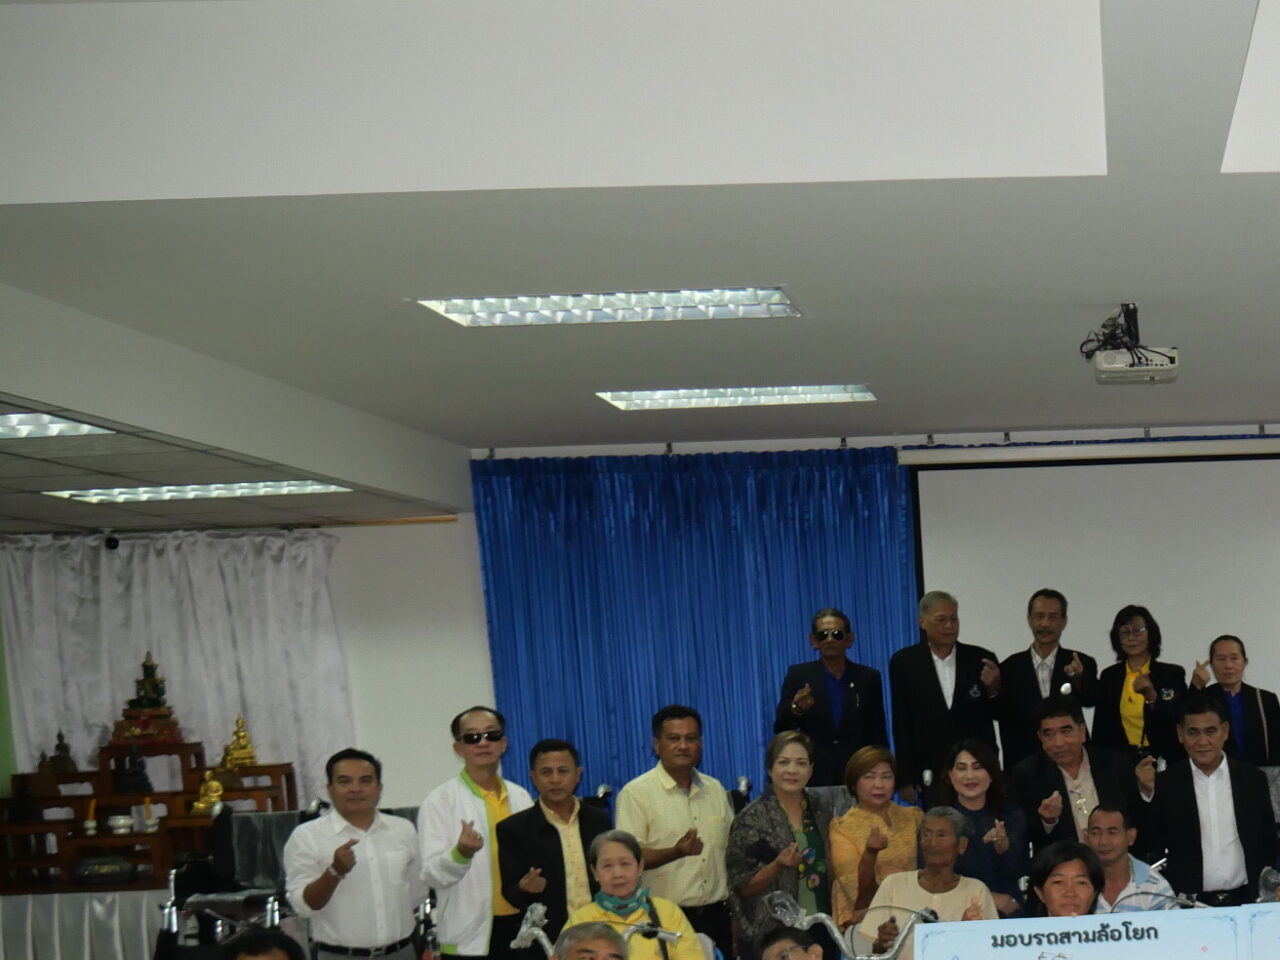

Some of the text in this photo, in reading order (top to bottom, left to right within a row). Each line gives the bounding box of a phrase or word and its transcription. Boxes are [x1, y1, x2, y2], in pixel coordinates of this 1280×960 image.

[991, 921, 1159, 949] มอบรถสามล้อโยก
